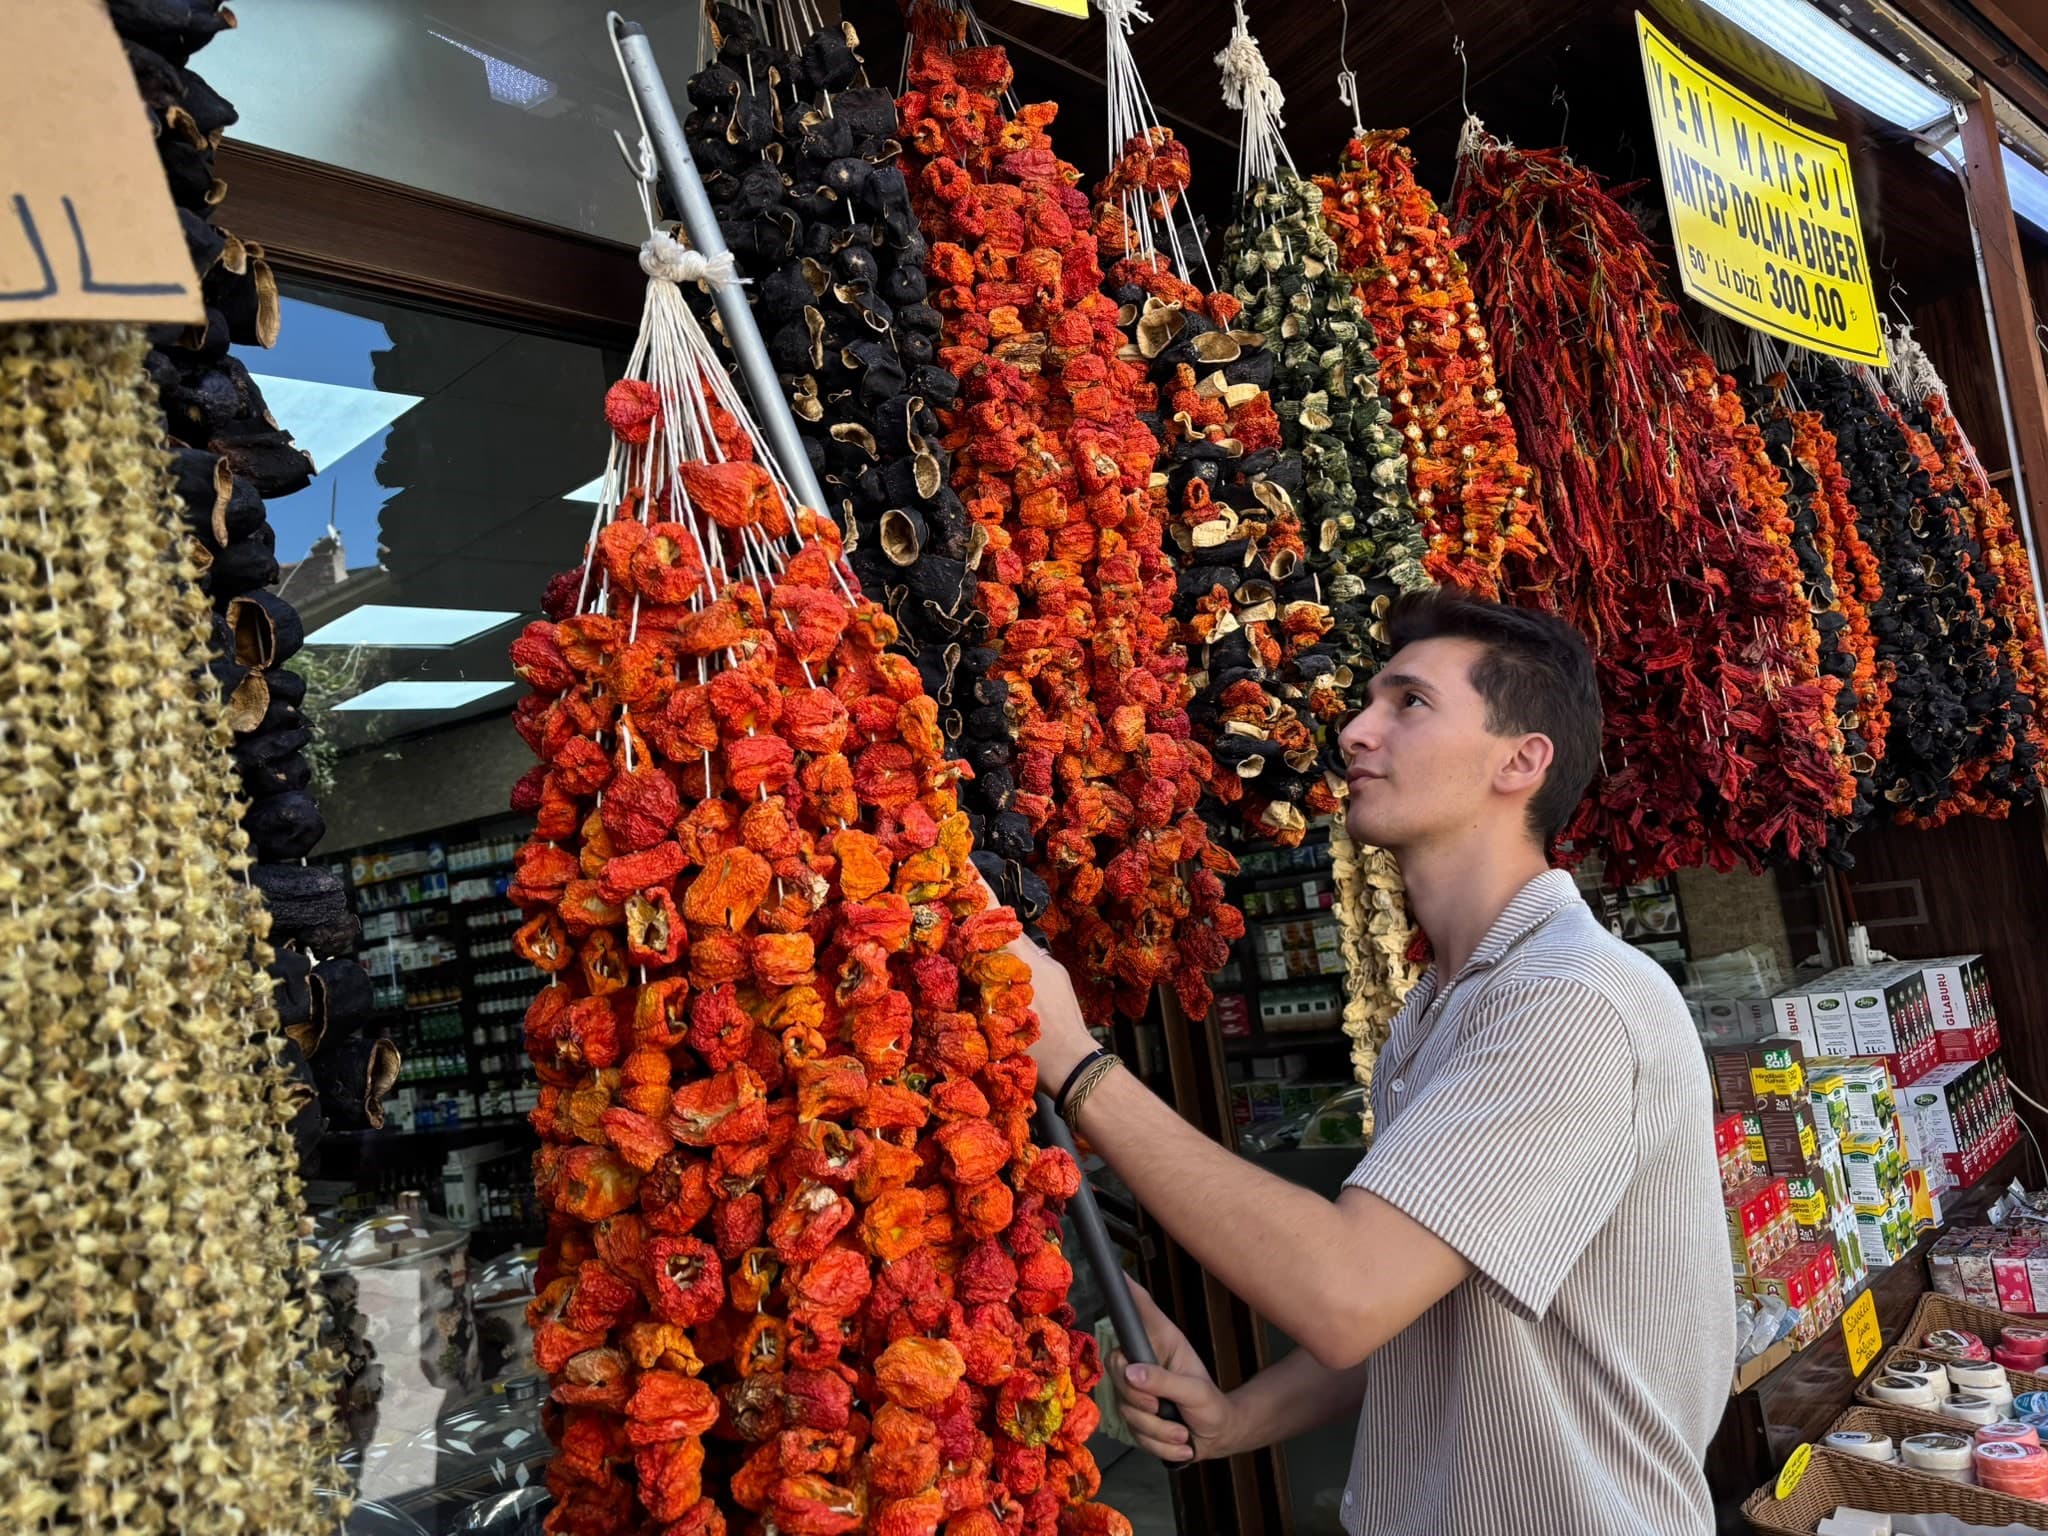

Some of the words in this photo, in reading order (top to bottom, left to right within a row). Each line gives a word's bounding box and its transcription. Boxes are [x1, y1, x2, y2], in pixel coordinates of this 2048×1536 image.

[1650, 56, 1721, 158] YENİ
[1731, 116, 1852, 220] MAHSUL
[1667, 141, 1729, 230] ANTEP
[1730, 182, 1800, 266] DOLMA
[1799, 207, 1864, 286] BİBER
[1765, 261, 1847, 332] 300,00
[1785, 1003, 1801, 1033] BURU
[1936, 974, 1955, 1026] GİLABURU
